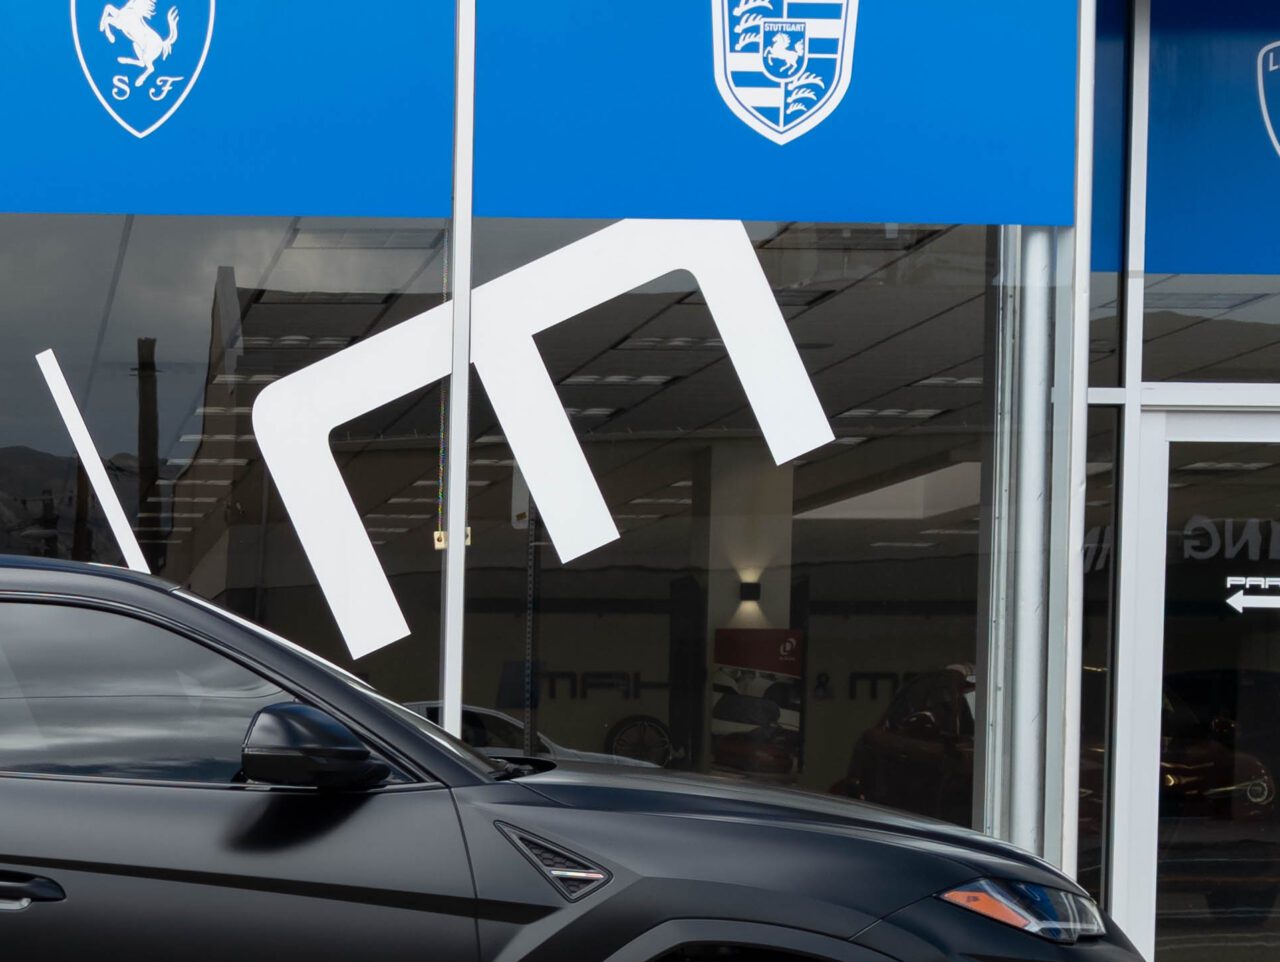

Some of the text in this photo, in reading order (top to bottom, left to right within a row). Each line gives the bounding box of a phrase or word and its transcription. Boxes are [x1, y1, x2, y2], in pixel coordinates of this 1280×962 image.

[764, 23, 805, 33] STUTTGART
[112, 75, 184, 101] S F
